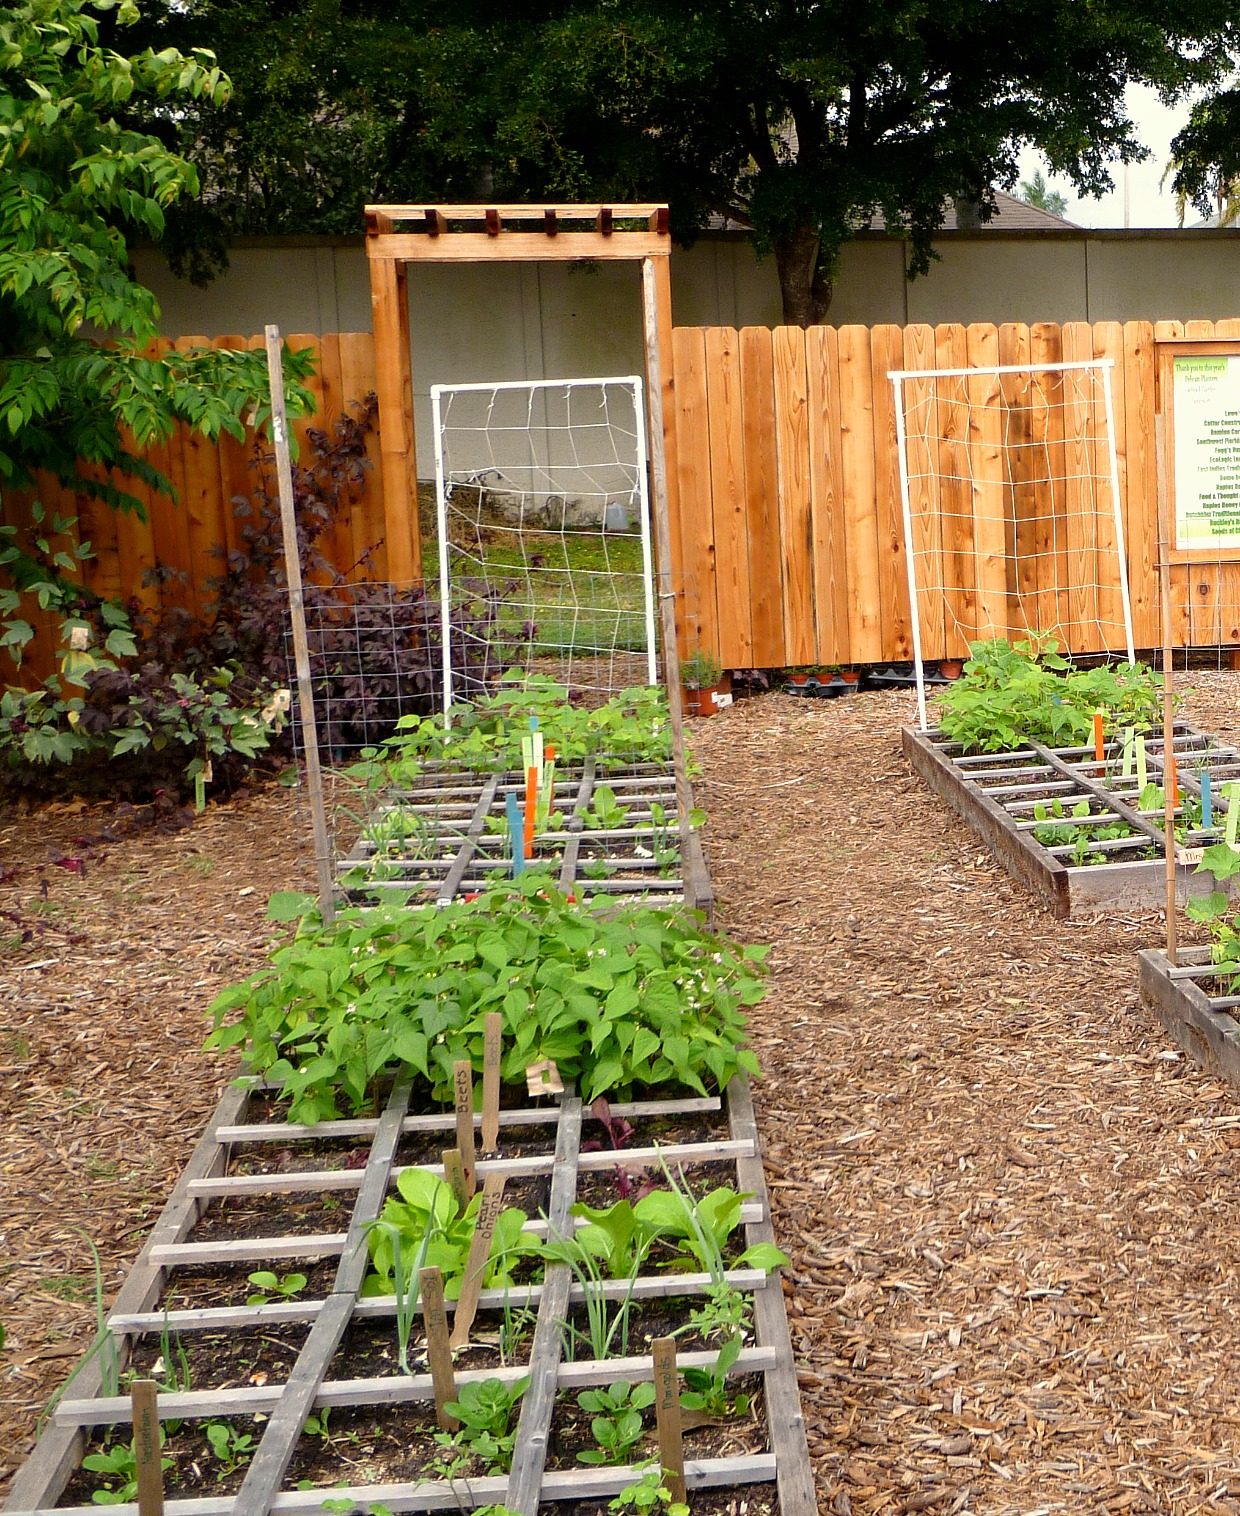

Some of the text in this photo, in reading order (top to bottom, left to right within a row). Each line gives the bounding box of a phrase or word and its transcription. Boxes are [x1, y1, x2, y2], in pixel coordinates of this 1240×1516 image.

[1176, 363, 1190, 372] Thank
[1204, 363, 1214, 371] this
[1213, 363, 1225, 373] year's
[1185, 374, 1200, 382] Pelican
[1215, 483, 1234, 491] Naples
[1217, 492, 1239, 500] Thought
[455, 1068, 469, 1113] Beets
[475, 1192, 491, 1230] Pearl
